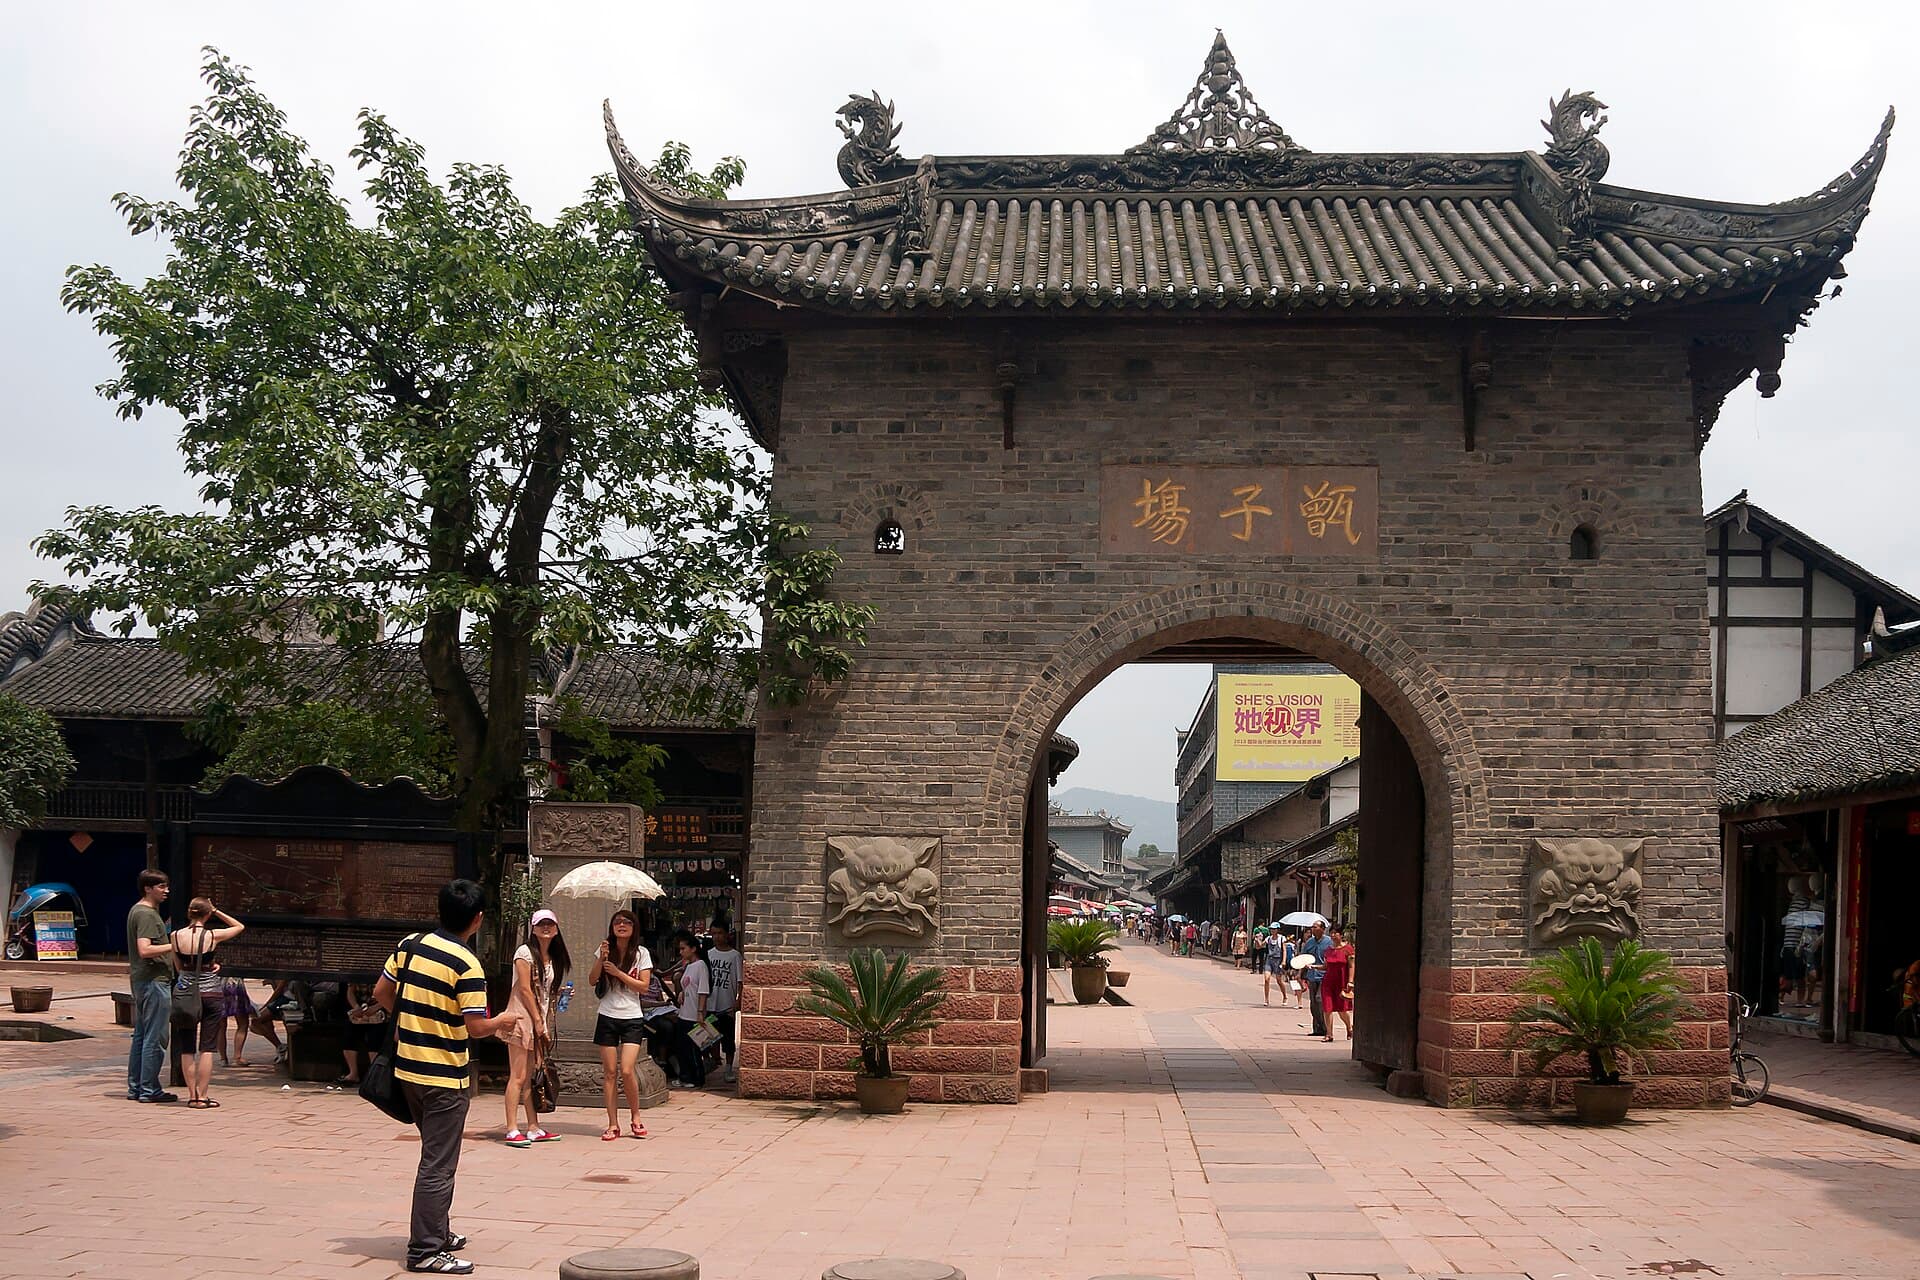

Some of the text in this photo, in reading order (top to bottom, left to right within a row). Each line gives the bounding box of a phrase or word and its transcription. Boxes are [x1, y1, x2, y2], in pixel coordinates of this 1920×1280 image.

[1234, 694, 1323, 706] SHE'S VISION
[1234, 706, 1322, 739] 她视界
